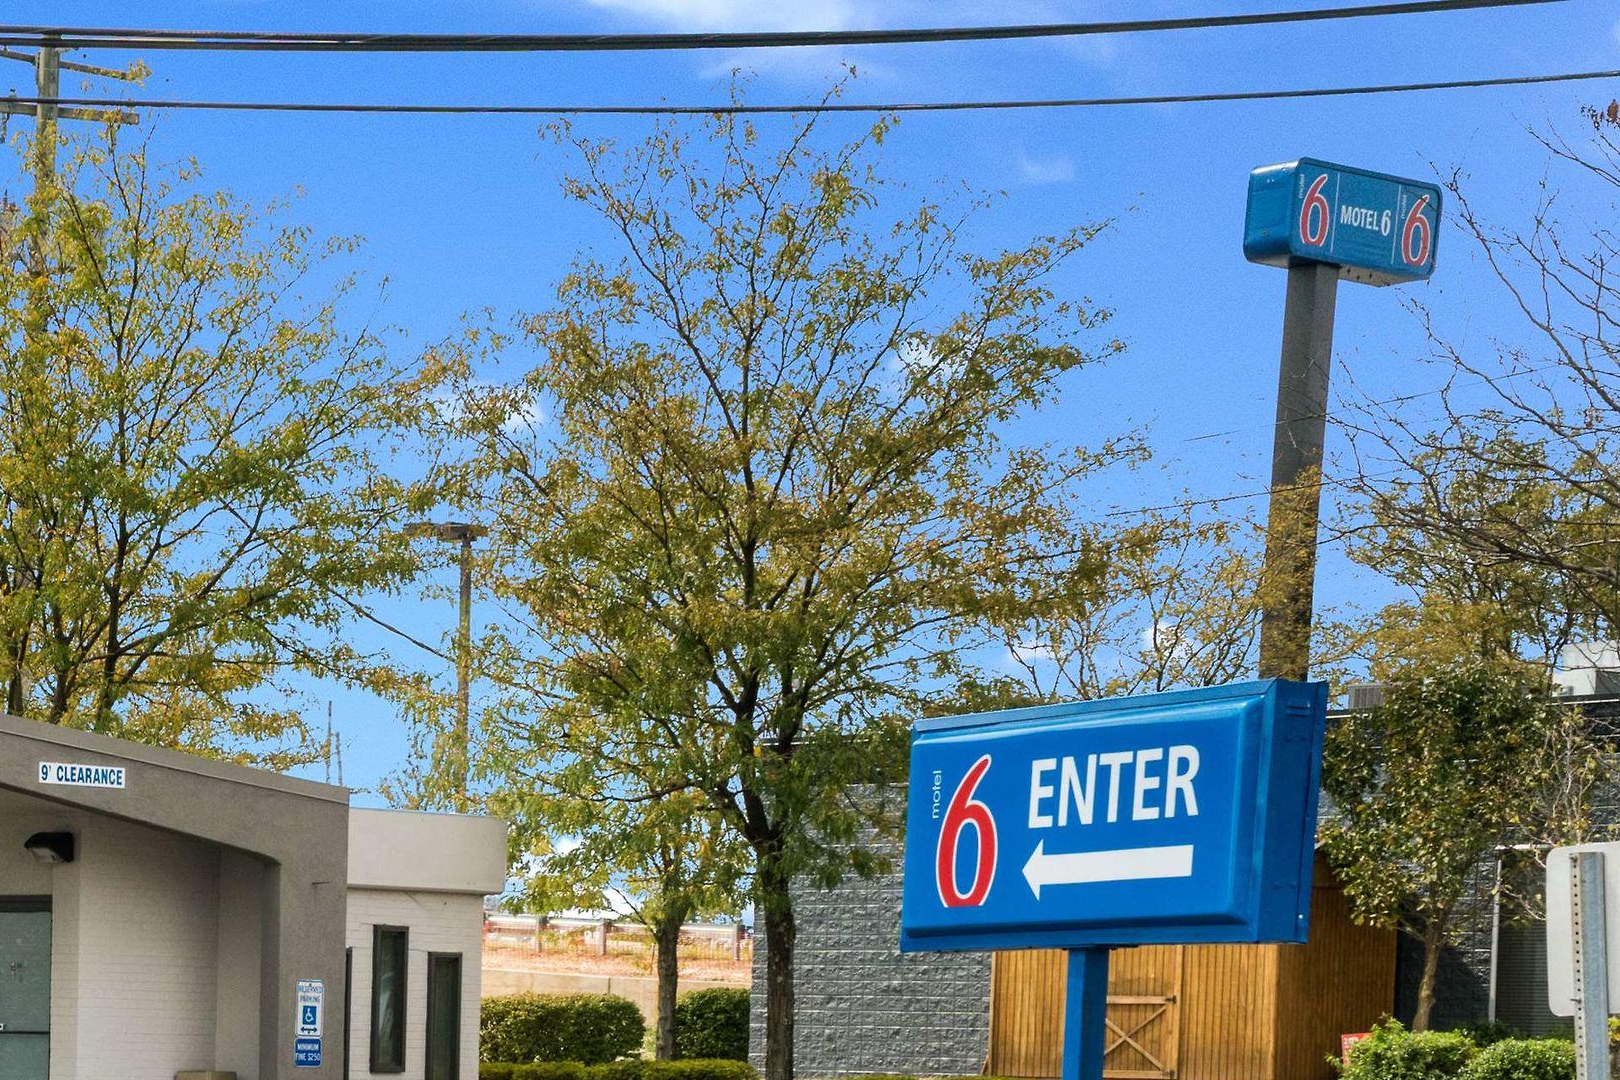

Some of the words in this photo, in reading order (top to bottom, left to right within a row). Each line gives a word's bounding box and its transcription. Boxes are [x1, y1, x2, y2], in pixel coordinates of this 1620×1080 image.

[1300, 174, 1329, 246] 6
[1340, 205, 1379, 231] MOTEL
[1381, 210, 1392, 237] 6
[1402, 195, 1430, 266] 6
[56, 764, 123, 786] CLEARANCE
[932, 769, 943, 820] motel
[1028, 744, 1201, 829] ENTER
[935, 753, 998, 909] 6
